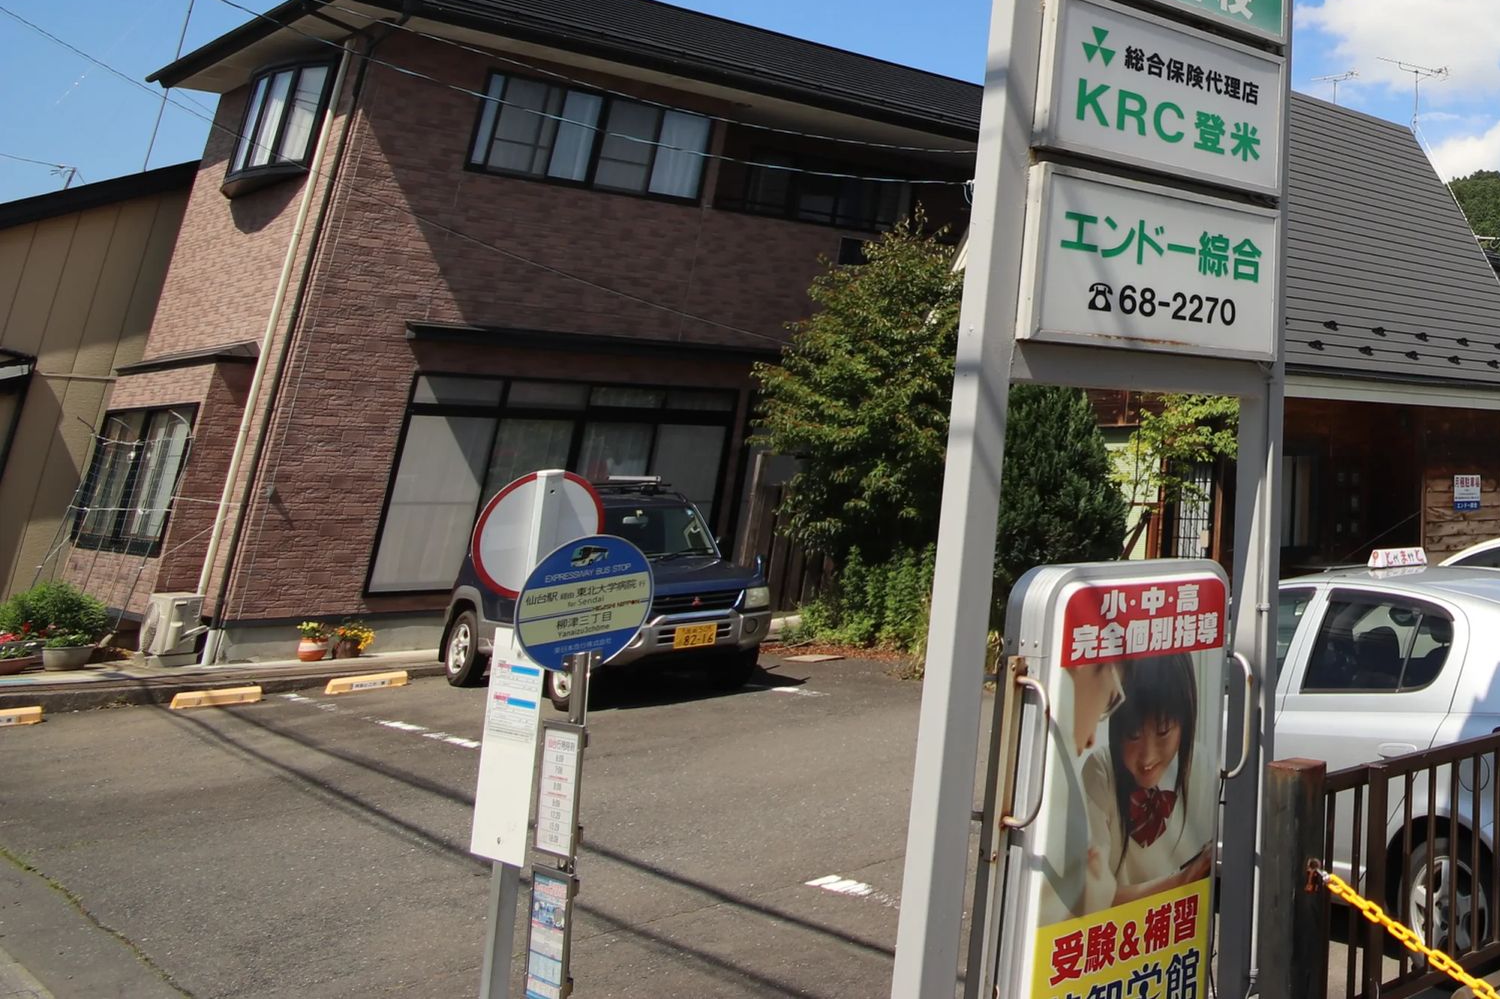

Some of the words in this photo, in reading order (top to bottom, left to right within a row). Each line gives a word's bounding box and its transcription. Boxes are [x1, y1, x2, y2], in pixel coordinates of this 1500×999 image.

[1123, 45, 1260, 106] 総合保険代理店
[544, 569, 594, 584] EXPRESSWAY
[595, 565, 611, 576] BUS
[612, 562, 632, 573] STOP
[556, 610, 613, 631] 柳津三丁目
[577, 595, 605, 607] Sendai
[1070, 611, 1219, 662] 完全個別指導
[1049, 893, 1200, 987] 受験&補習
[1051, 947, 1200, 999] 学館
